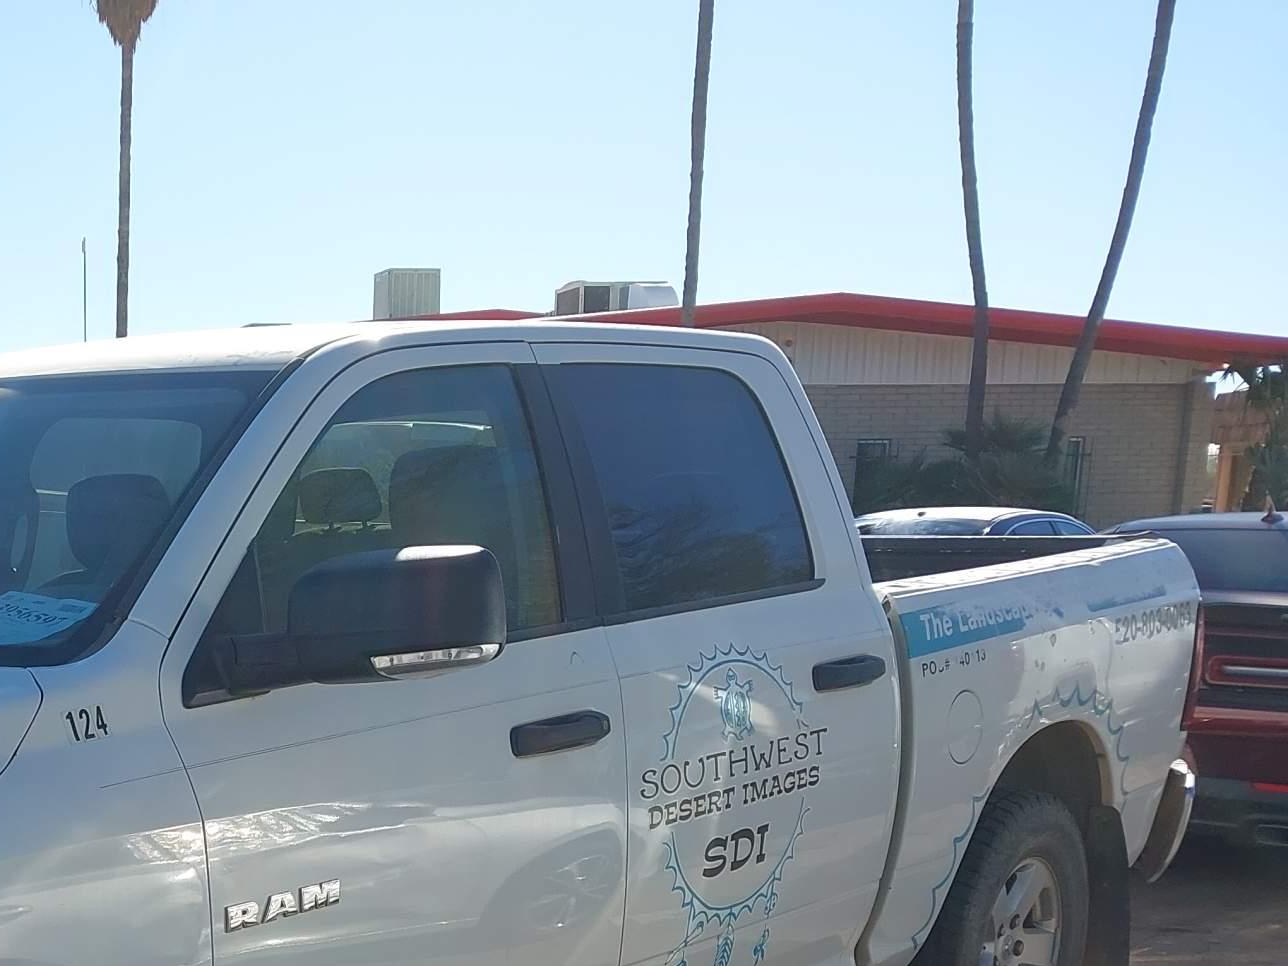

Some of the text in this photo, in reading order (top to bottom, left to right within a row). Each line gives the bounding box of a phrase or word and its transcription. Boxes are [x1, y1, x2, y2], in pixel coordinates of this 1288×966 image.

[920, 611, 954, 640] The
[65, 705, 108, 742] 124
[640, 728, 828, 799] SOUTHWEST
[648, 765, 820, 830] DESERT IMAGES
[702, 823, 770, 878] SDI
[224, 878, 341, 933] RAM
